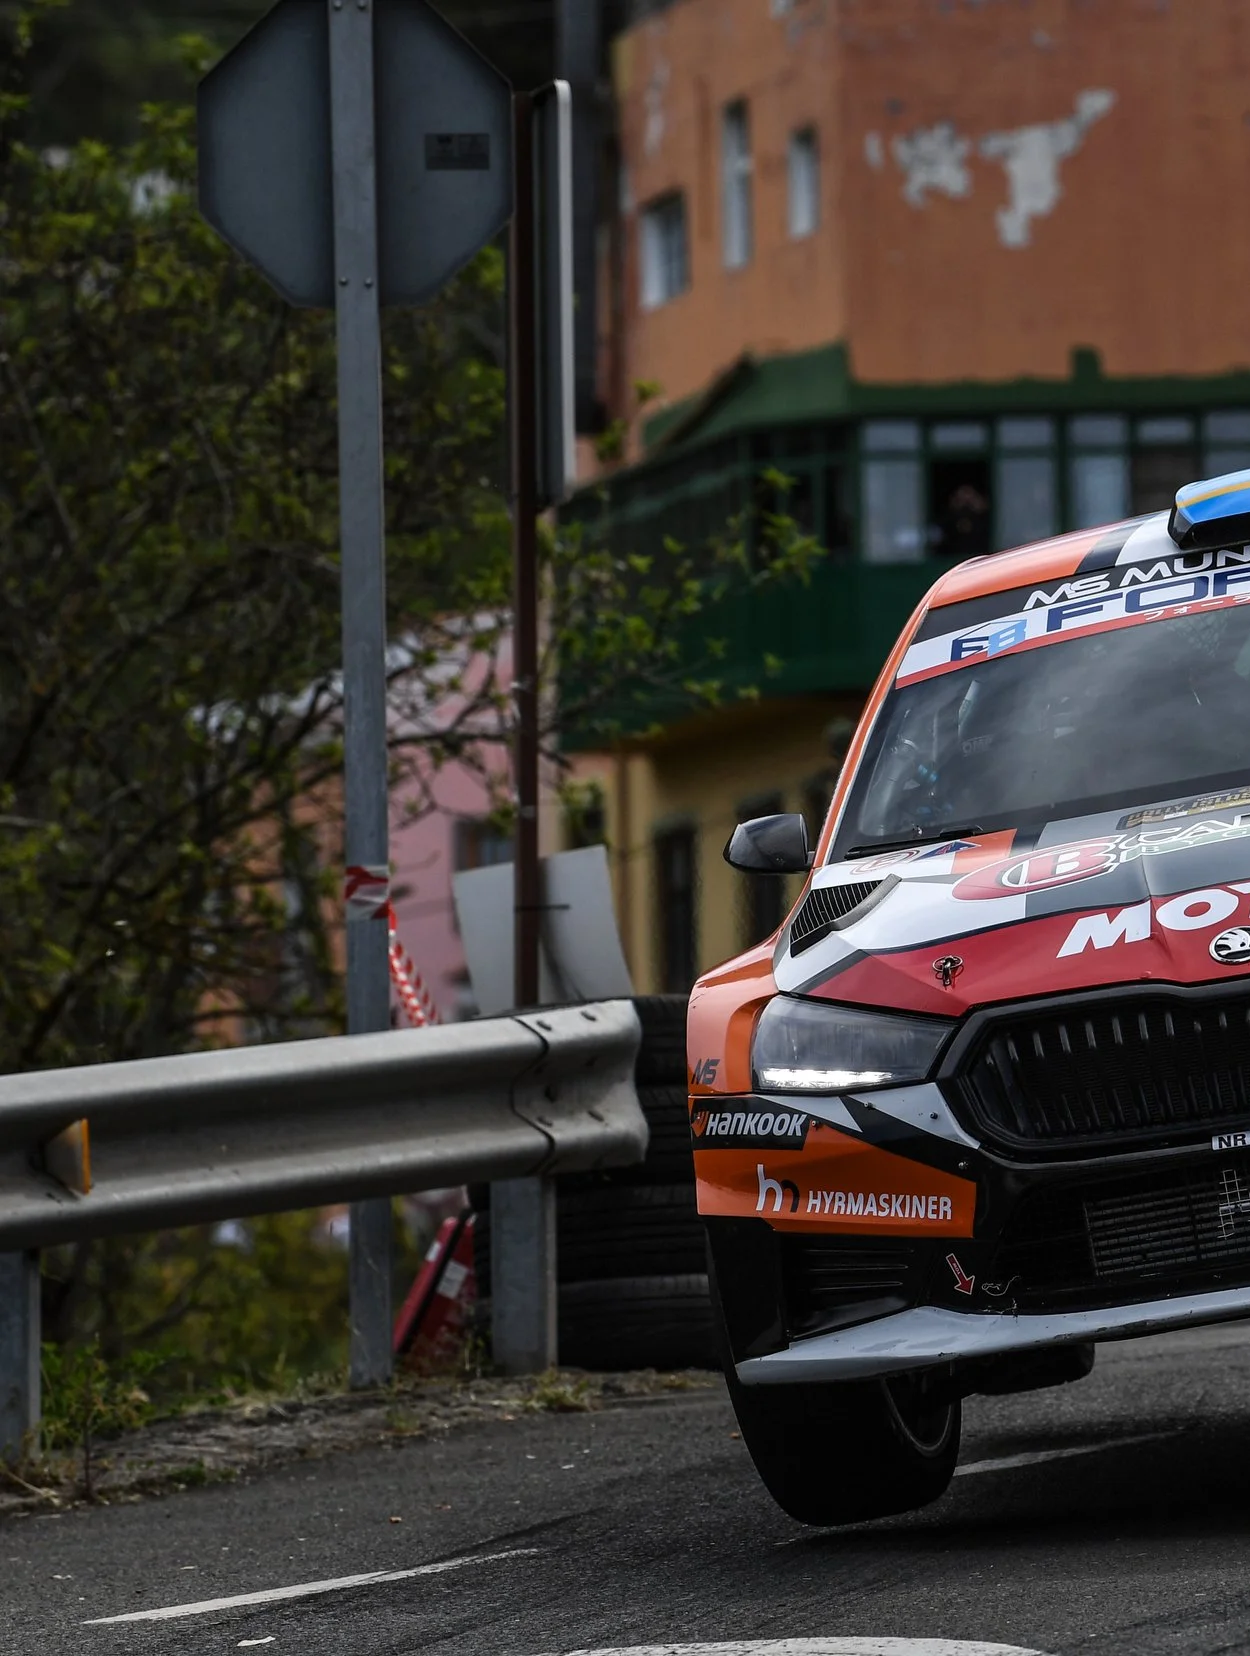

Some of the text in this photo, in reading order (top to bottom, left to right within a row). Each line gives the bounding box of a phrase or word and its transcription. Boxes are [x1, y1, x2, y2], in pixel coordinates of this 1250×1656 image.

[1023, 573, 1111, 611] MS
[1218, 1133, 1247, 1149] NR
[806, 1190, 953, 1220] HYRMASKINER
